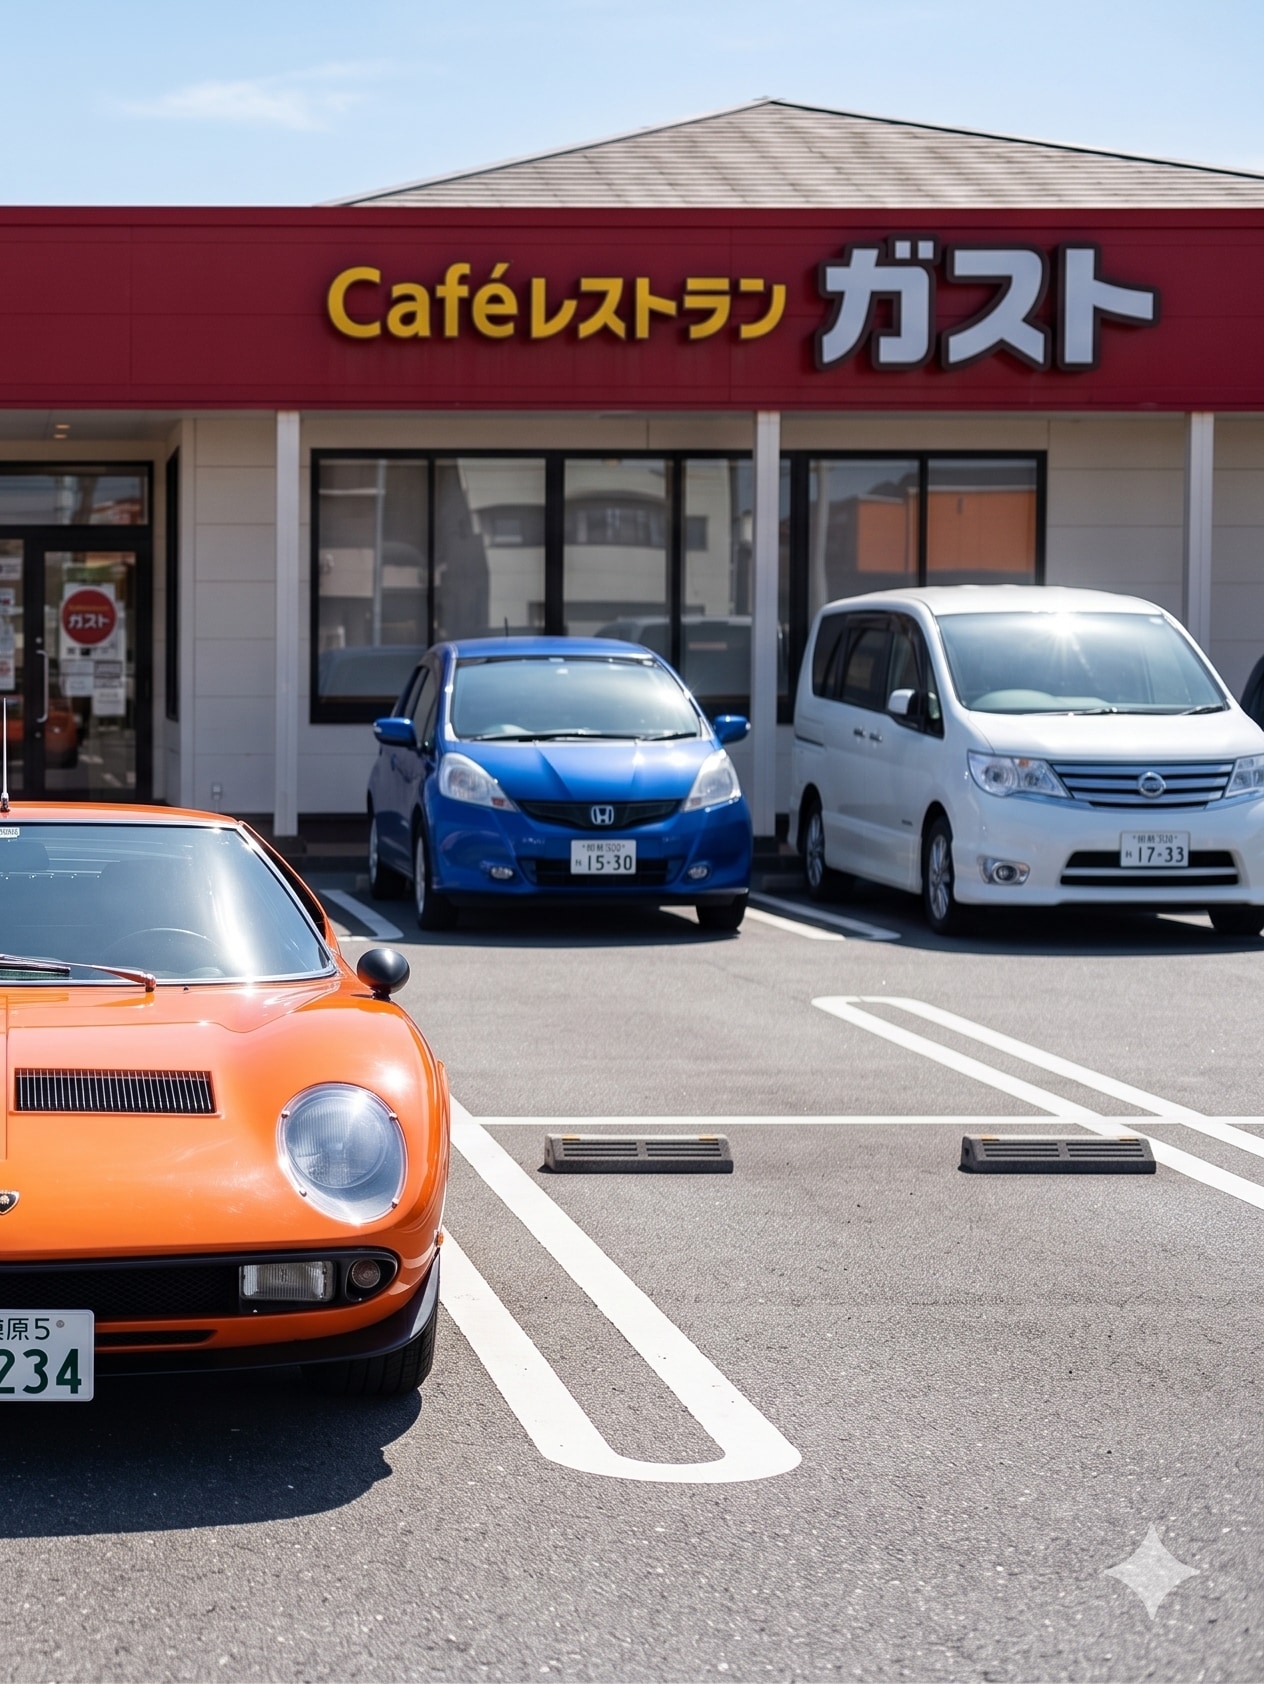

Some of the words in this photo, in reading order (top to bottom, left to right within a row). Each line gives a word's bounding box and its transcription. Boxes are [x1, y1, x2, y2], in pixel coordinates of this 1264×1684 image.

[820, 239, 1155, 365] ガスト
[67, 613, 111, 629] ガスト
